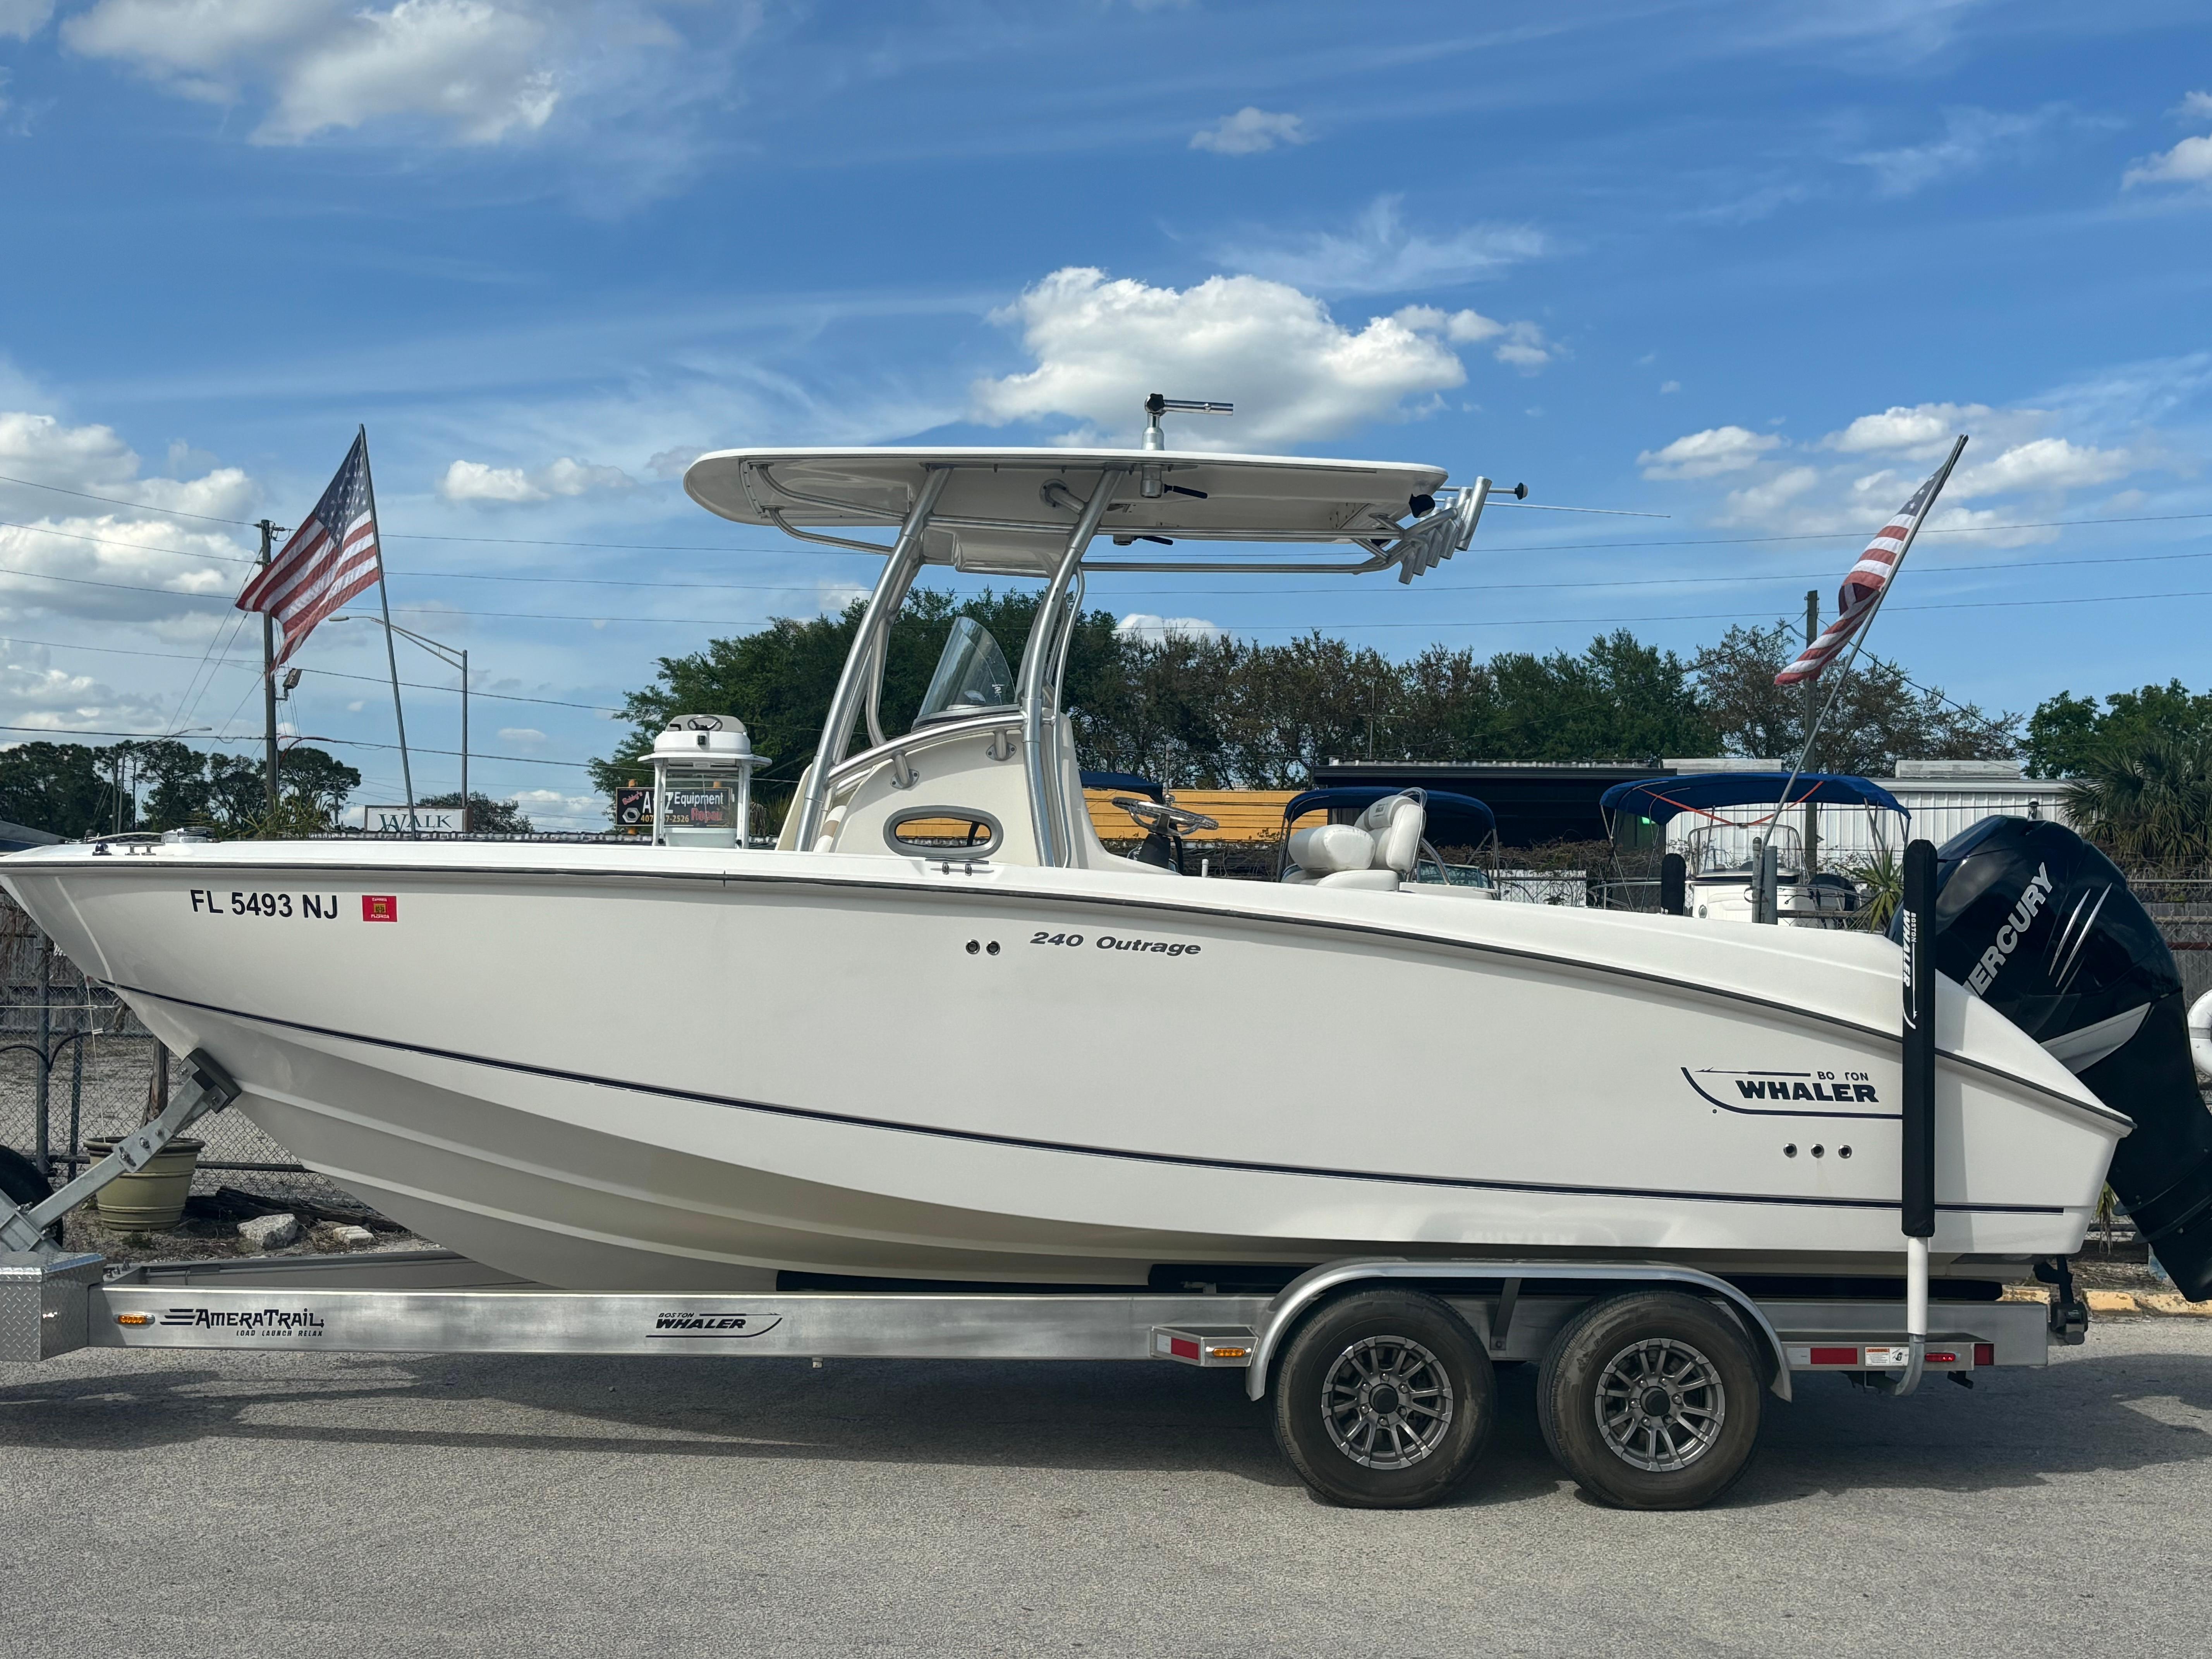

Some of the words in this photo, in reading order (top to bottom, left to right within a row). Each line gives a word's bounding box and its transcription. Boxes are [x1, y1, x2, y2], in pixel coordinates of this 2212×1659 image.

[674, 792, 723, 807] Equipment
[378, 814, 452, 832] WALK
[190, 890, 223, 914] FL
[232, 892, 293, 918] 5493
[302, 895, 338, 919] NJ
[1962, 862, 2052, 998] ERCURY
[1030, 932, 1084, 947] 240
[1096, 936, 1201, 957] Outrage
[1817, 1071, 1869, 1081] BOTON
[1735, 1080, 1879, 1103] WHALER
[656, 1319, 746, 1328] WHALER
